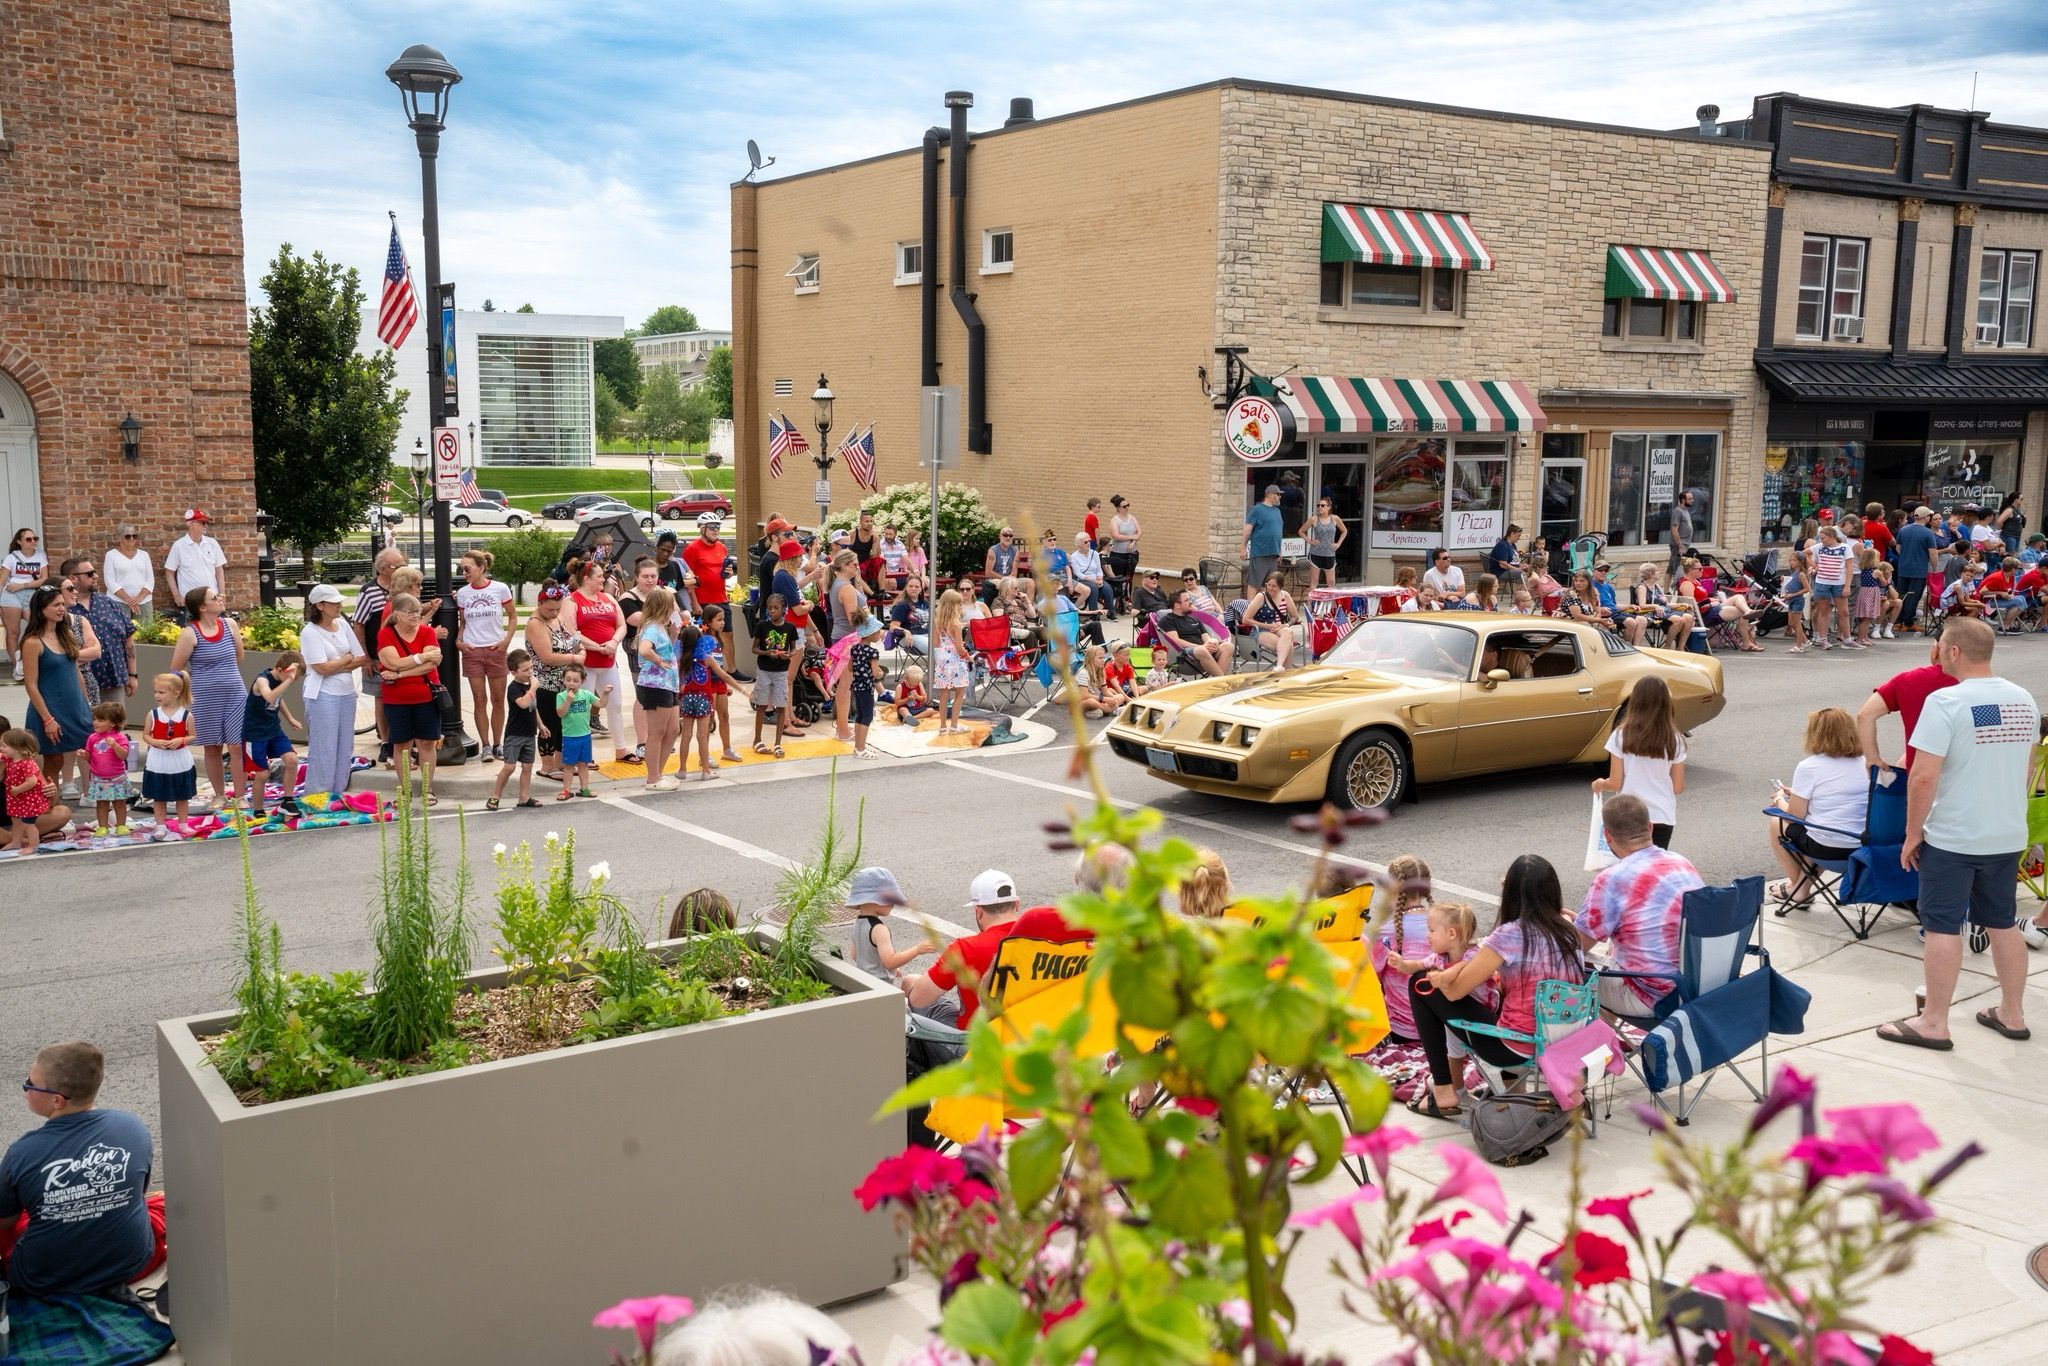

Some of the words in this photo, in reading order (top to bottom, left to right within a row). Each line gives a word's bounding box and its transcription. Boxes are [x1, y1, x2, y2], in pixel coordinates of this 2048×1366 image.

[1240, 403, 1270, 424] Sal's
[1388, 420, 1409, 431] Sal's
[1413, 419, 1447, 431] PERIA
[1232, 432, 1272, 456] Pizzeria
[1653, 450, 1673, 465] Salon
[1651, 471, 1673, 486] Fusion
[1457, 513, 1493, 530] Pizza
[1388, 533, 1428, 545] Appetizers
[1456, 536, 1466, 547] by
[1467, 534, 1478, 544] the
[1479, 534, 1494, 544] slice
[1283, 542, 1304, 554] Wings
[1378, 741, 1400, 765] COOPER
[1391, 768, 1402, 800] COBRA
[1031, 952, 1089, 980] PACK
[41, 1148, 118, 1191] Roden
[43, 1183, 88, 1199] BARNYARD
[43, 1187, 98, 1205] ADVENTURES,
[100, 1185, 115, 1193] LLC
